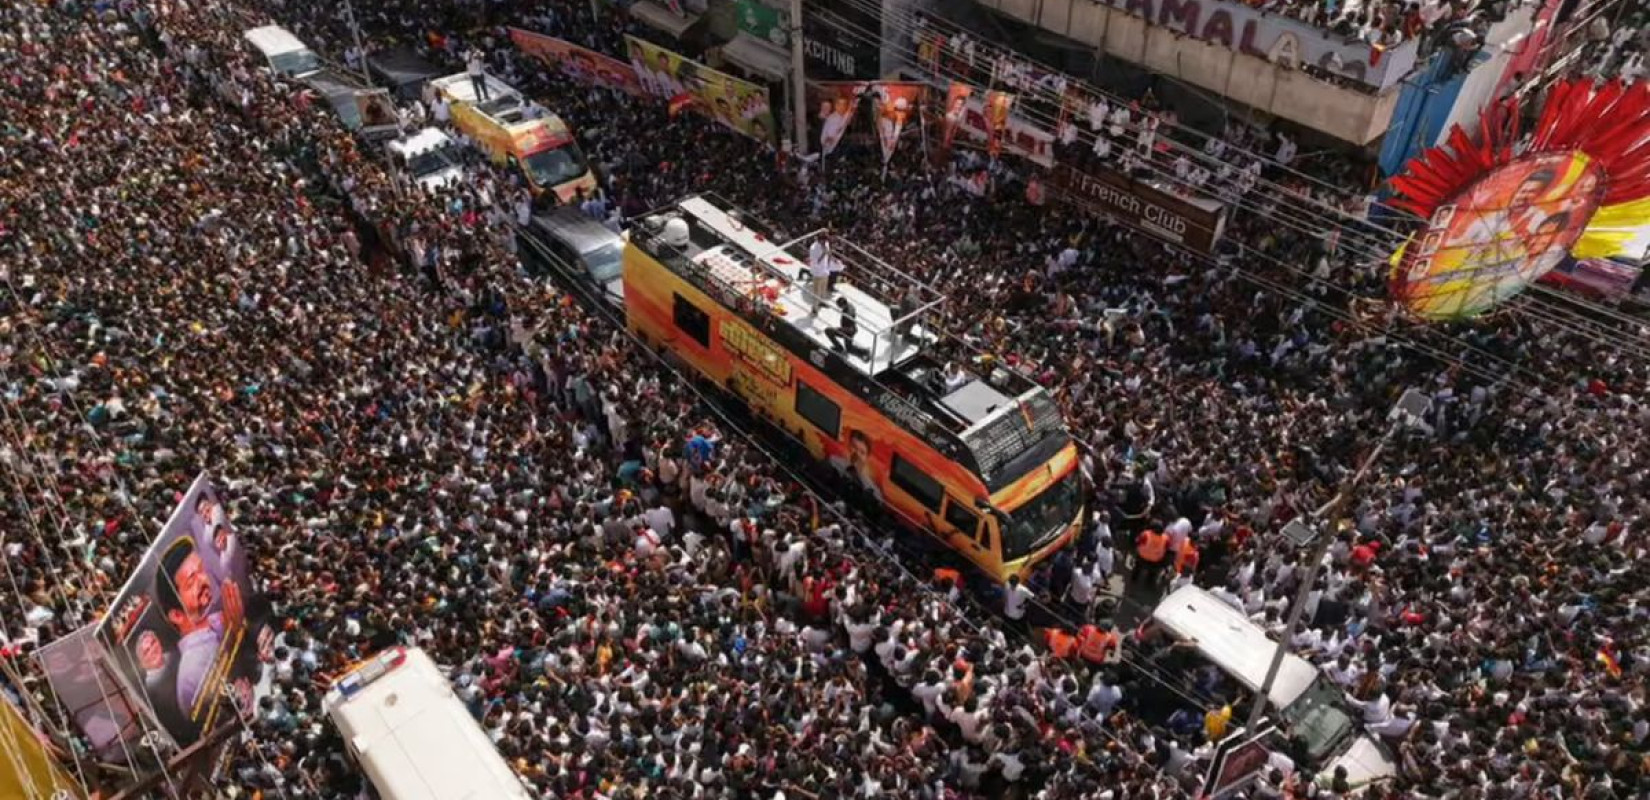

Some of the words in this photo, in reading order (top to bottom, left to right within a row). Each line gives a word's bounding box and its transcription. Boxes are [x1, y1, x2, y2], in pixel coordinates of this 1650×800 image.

[803, 36, 855, 75] XCITING
[1106, 0, 1300, 69] AMALA
[1081, 174, 1140, 215] French
[1144, 204, 1187, 234] Club
